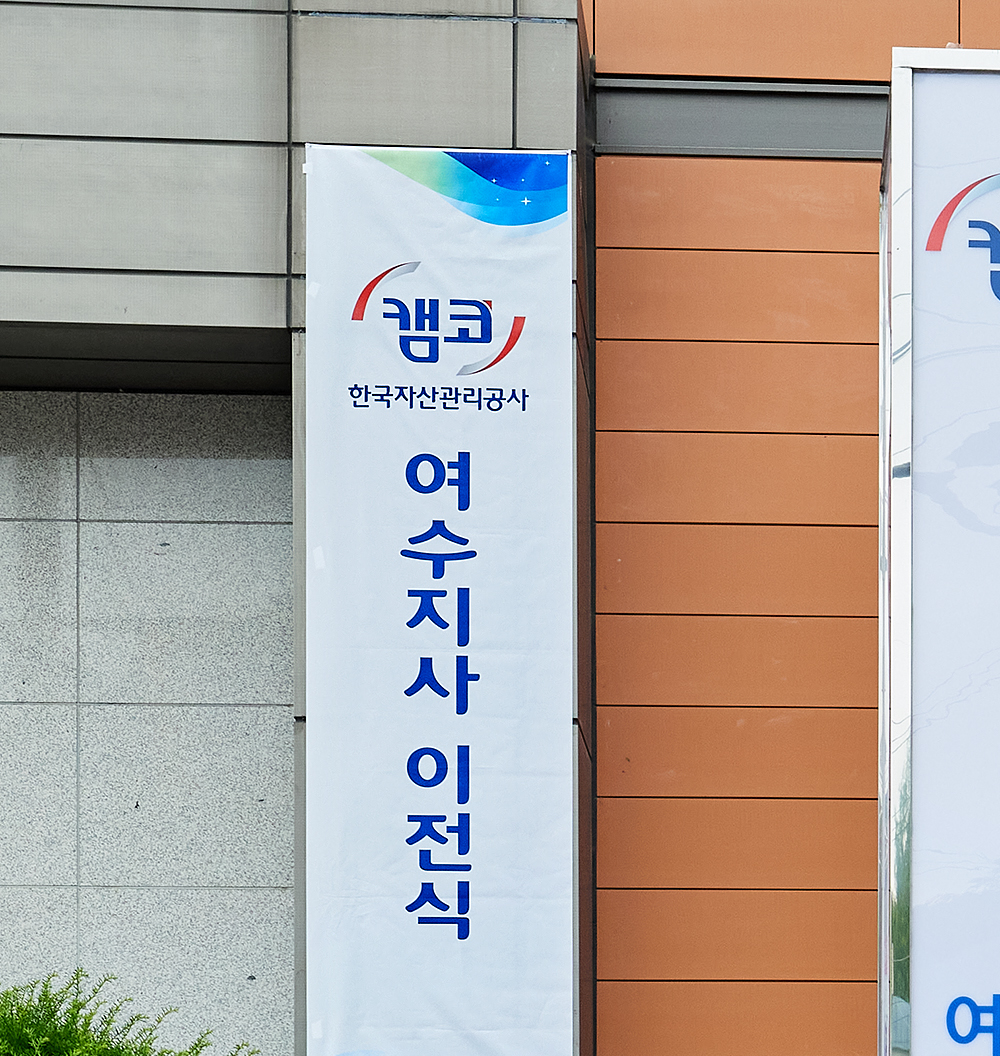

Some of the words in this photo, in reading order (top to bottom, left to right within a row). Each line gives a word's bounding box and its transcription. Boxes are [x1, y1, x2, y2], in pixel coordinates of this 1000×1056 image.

[382, 297, 493, 364] 캠코
[348, 384, 529, 412] 한국자산관리공사
[399, 451, 481, 716] 여수지사
[404, 744, 473, 941] 이전식
